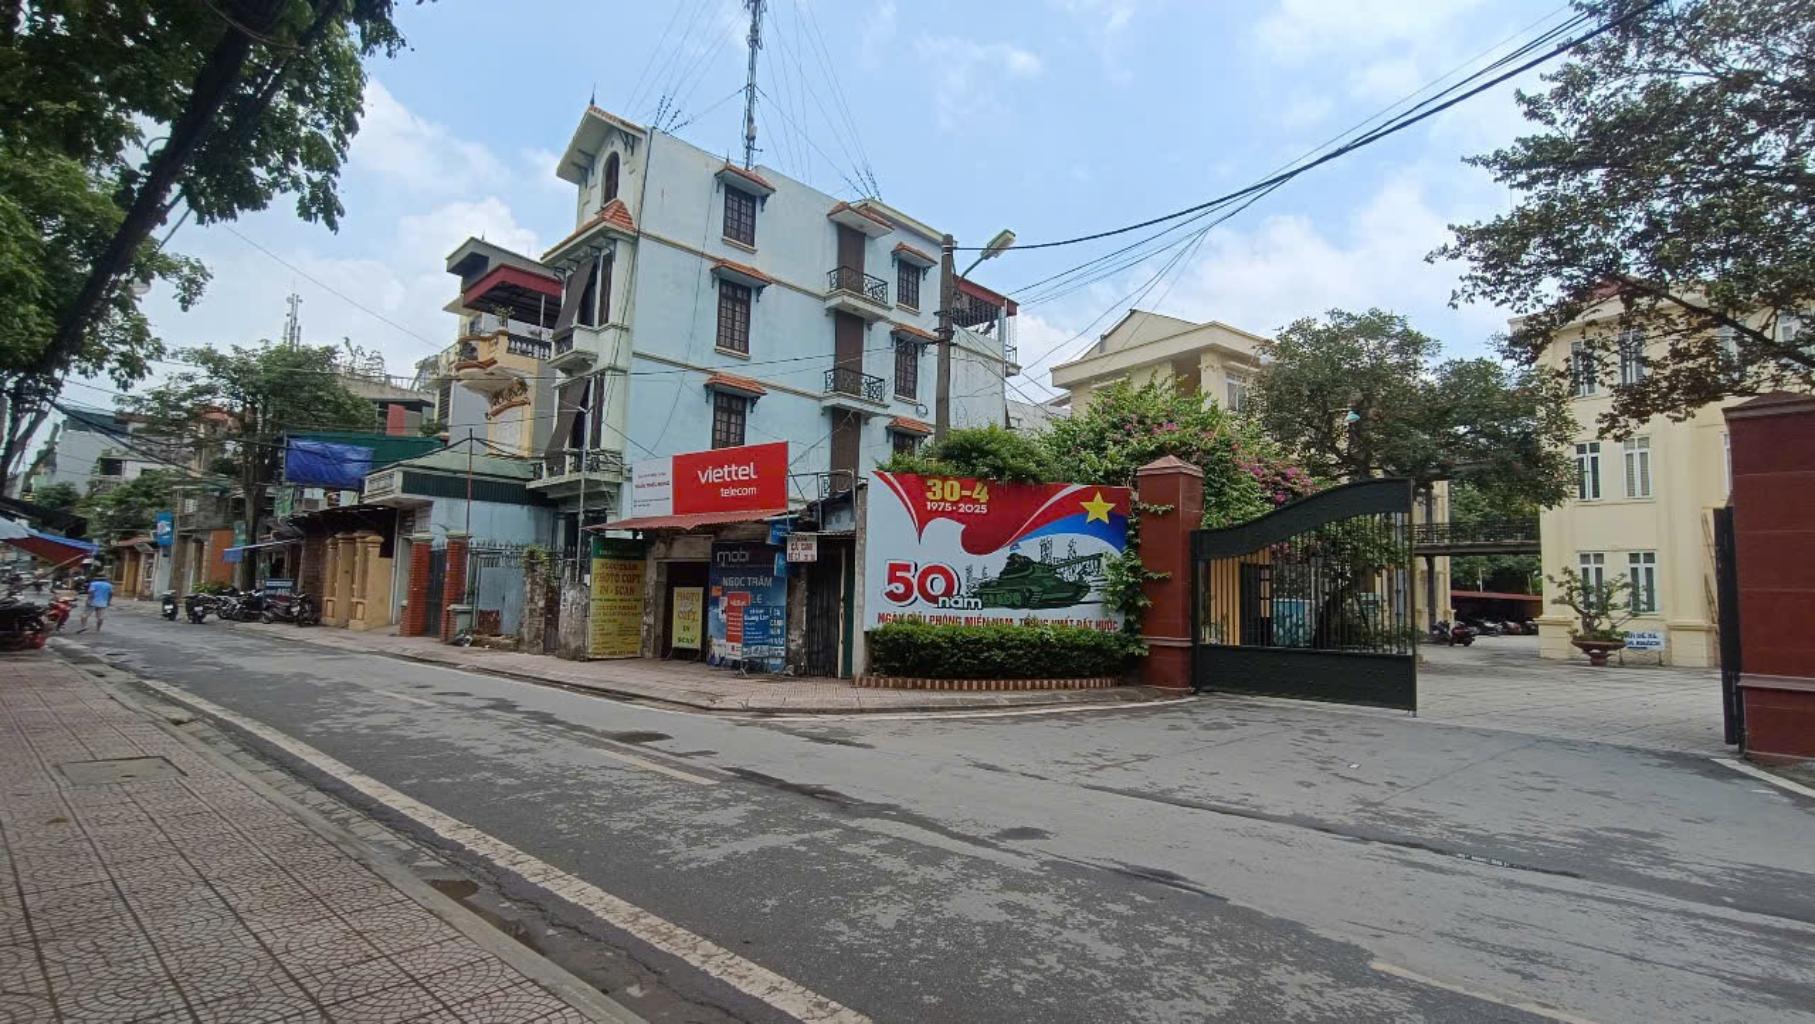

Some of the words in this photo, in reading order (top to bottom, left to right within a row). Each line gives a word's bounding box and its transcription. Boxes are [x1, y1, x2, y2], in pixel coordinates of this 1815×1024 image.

[697, 462, 758, 485] viettel
[720, 486, 757, 498] telecom
[925, 478, 989, 503] 30-4
[882, 559, 961, 607] 50
